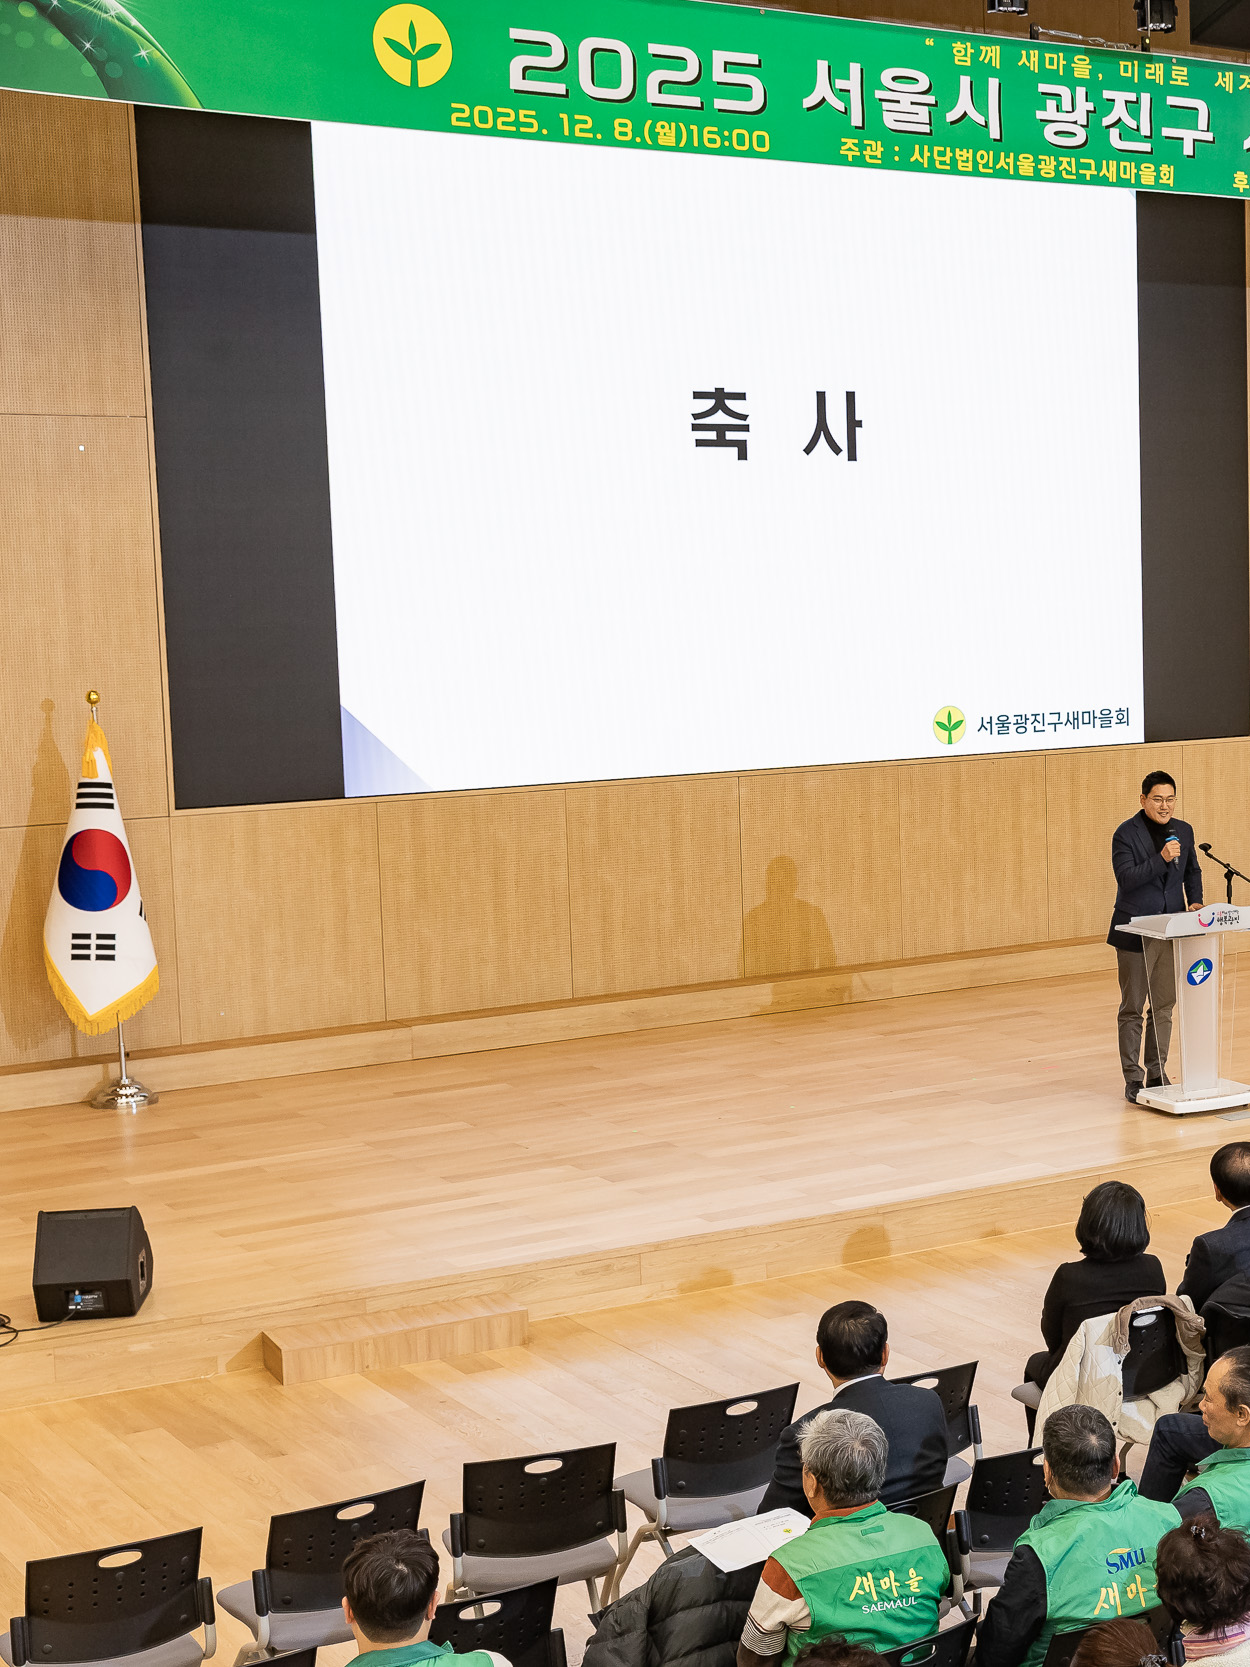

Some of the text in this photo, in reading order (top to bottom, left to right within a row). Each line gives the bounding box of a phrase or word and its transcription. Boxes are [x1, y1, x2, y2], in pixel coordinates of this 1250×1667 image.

[951, 40, 1001, 70] 함께
[1016, 49, 1104, 82] 새마을,
[1118, 58, 1191, 88] 미래로
[508, 26, 767, 114] 2025
[801, 58, 1002, 142] 서울시
[1034, 82, 1217, 158] 광진구
[450, 101, 549, 136] 2025.
[558, 112, 603, 141] 12.
[838, 136, 885, 165] 주관
[909, 143, 1175, 188] 사단법인서울광진구새마을회
[976, 706, 1130, 736] 서울광진구새마을회
[1105, 1546, 1148, 1575] SMU
[848, 1567, 924, 1602] 새마을
[1093, 1573, 1159, 1616] 새마
[861, 1595, 918, 1615] SAEMAUL
